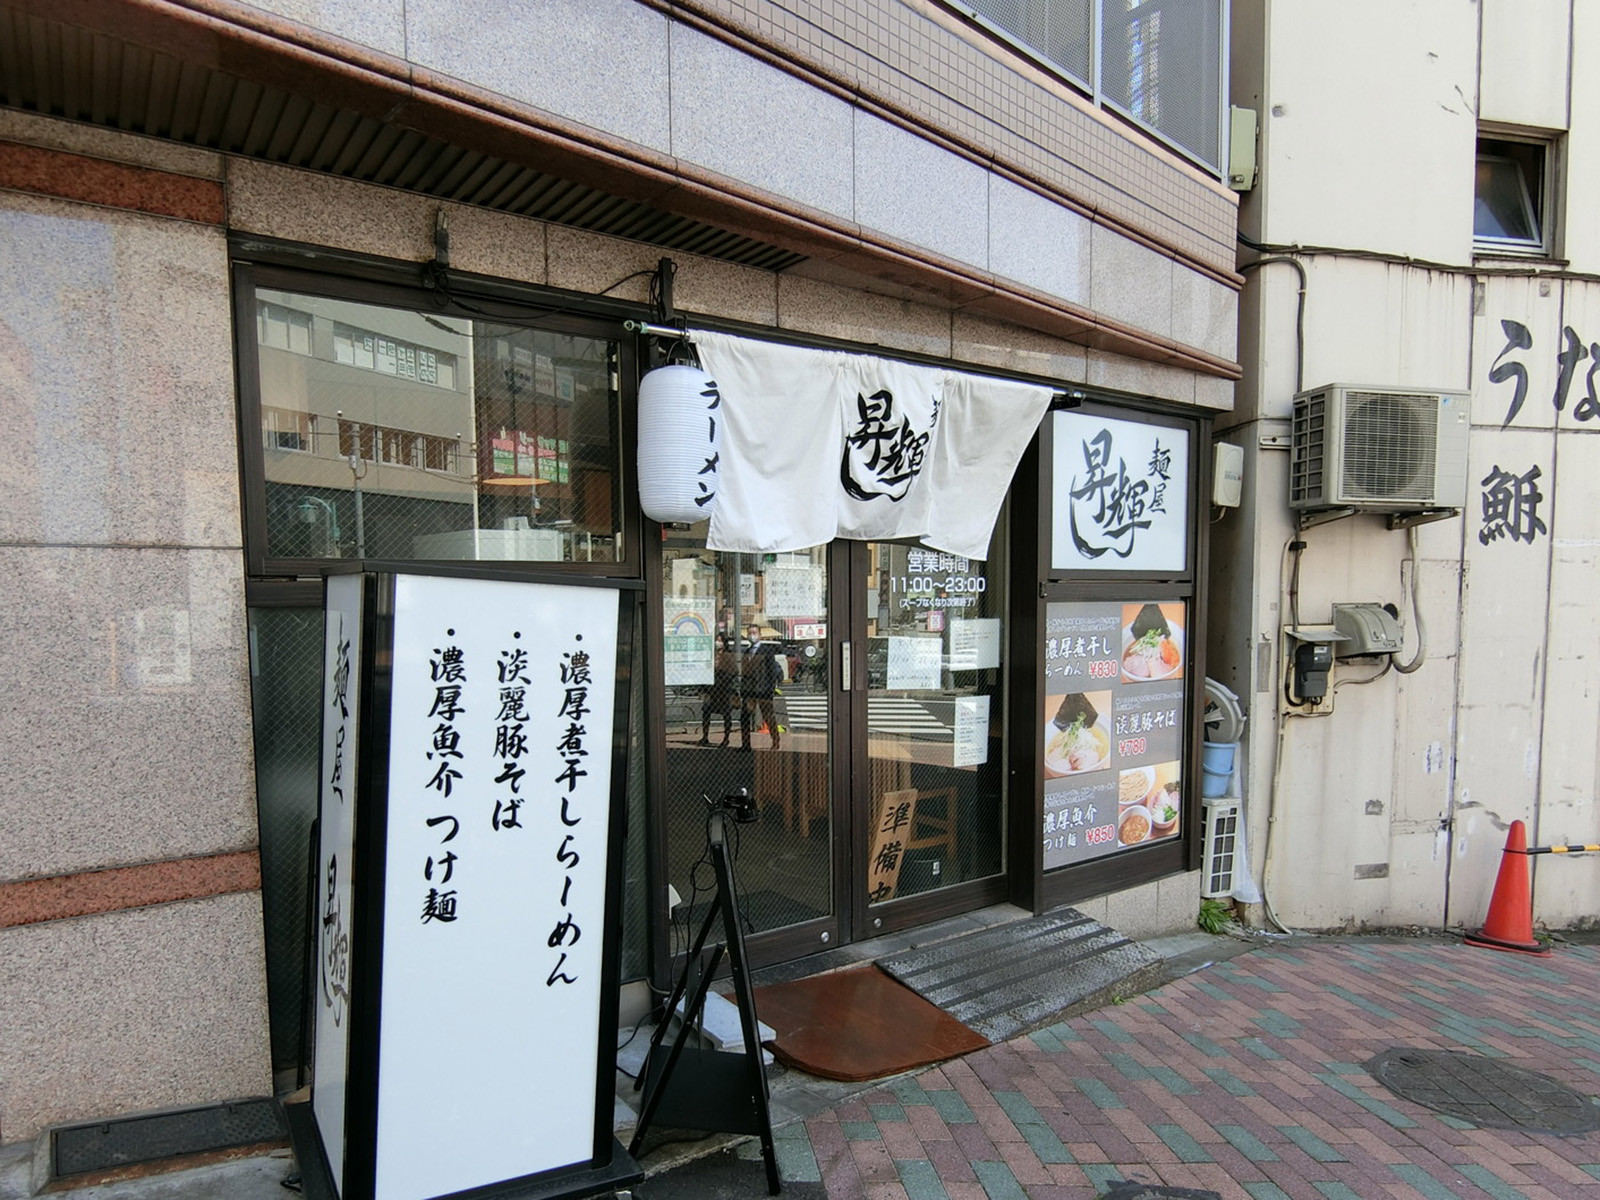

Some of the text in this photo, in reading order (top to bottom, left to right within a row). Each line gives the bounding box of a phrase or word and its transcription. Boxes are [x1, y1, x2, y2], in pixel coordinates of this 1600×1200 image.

[694, 380, 720, 507] ラーメン
[1147, 437, 1171, 515] 麺屋
[1069, 428, 1152, 560] 昇輝
[907, 551, 970, 573] 営業時間
[890, 577, 986, 593] 11:00～23:00
[1046, 636, 1112, 660] 濃厚煮干し
[1045, 662, 1083, 678] らーめん
[1088, 660, 1118, 678] ¥830
[1115, 709, 1176, 735] 淡麗豚そば
[1118, 737, 1146, 757] ¥780
[1043, 803, 1098, 833] 濃厚魚介
[1043, 832, 1077, 852] つけ麺
[1086, 824, 1115, 846] ¥850
